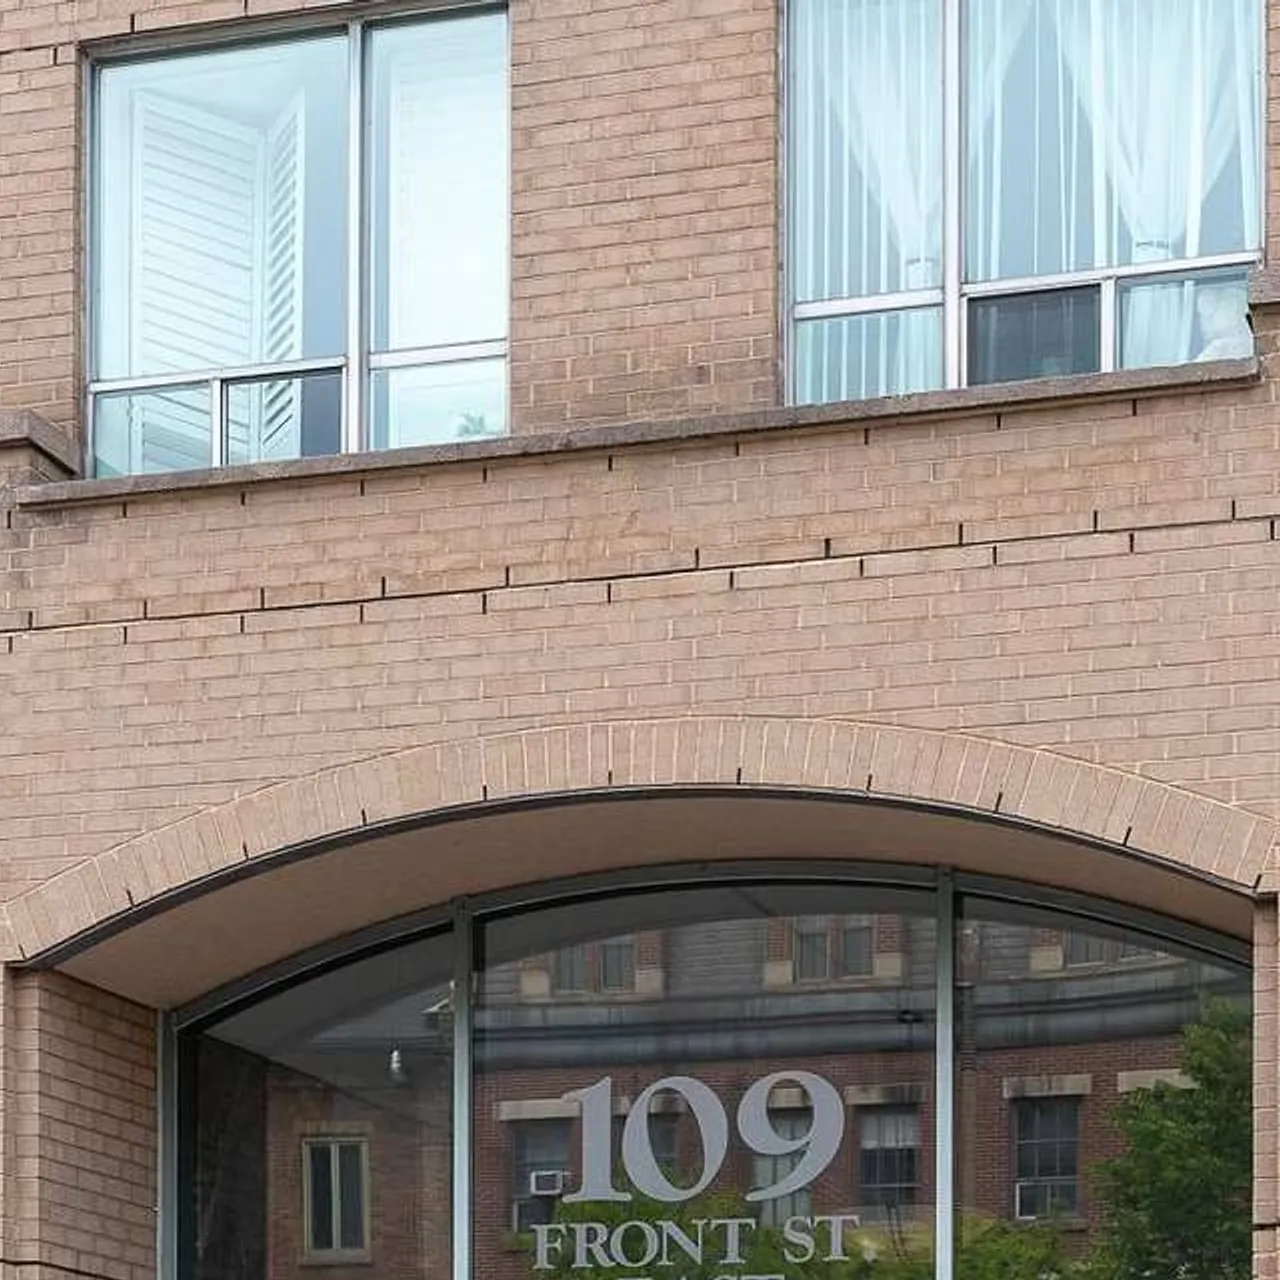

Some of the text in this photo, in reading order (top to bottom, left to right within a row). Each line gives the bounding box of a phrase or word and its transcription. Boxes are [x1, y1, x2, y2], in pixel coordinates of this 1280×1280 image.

[562, 1070, 844, 1201] 109
[530, 1215, 860, 1269] FRONT ST
